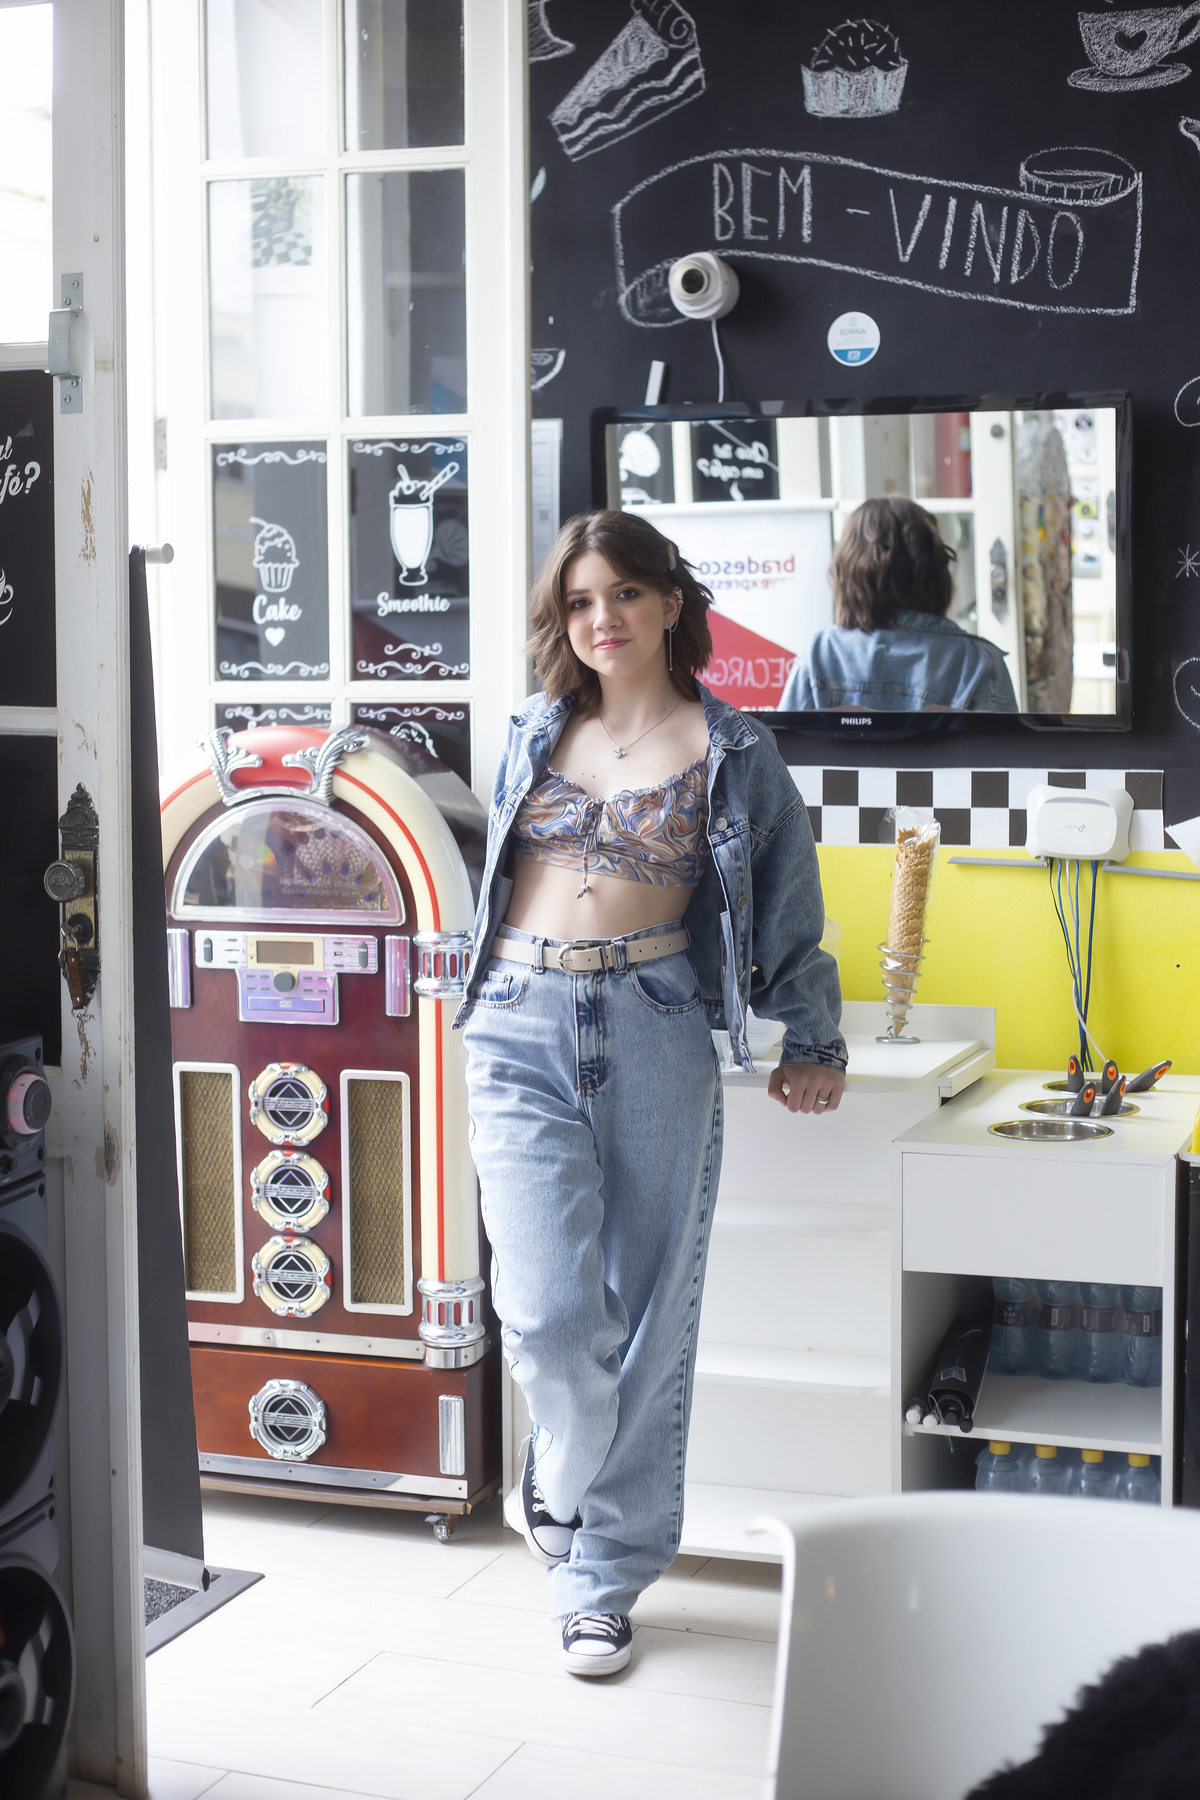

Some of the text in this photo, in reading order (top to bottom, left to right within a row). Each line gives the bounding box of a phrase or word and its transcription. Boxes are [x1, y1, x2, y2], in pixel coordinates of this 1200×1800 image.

[712, 162, 812, 243] BEM
[889, 188, 1085, 290] VINDO
[252, 594, 302, 625] Cake
[377, 591, 450, 617] Smoothie
[841, 717, 872, 726] PHILIPS
